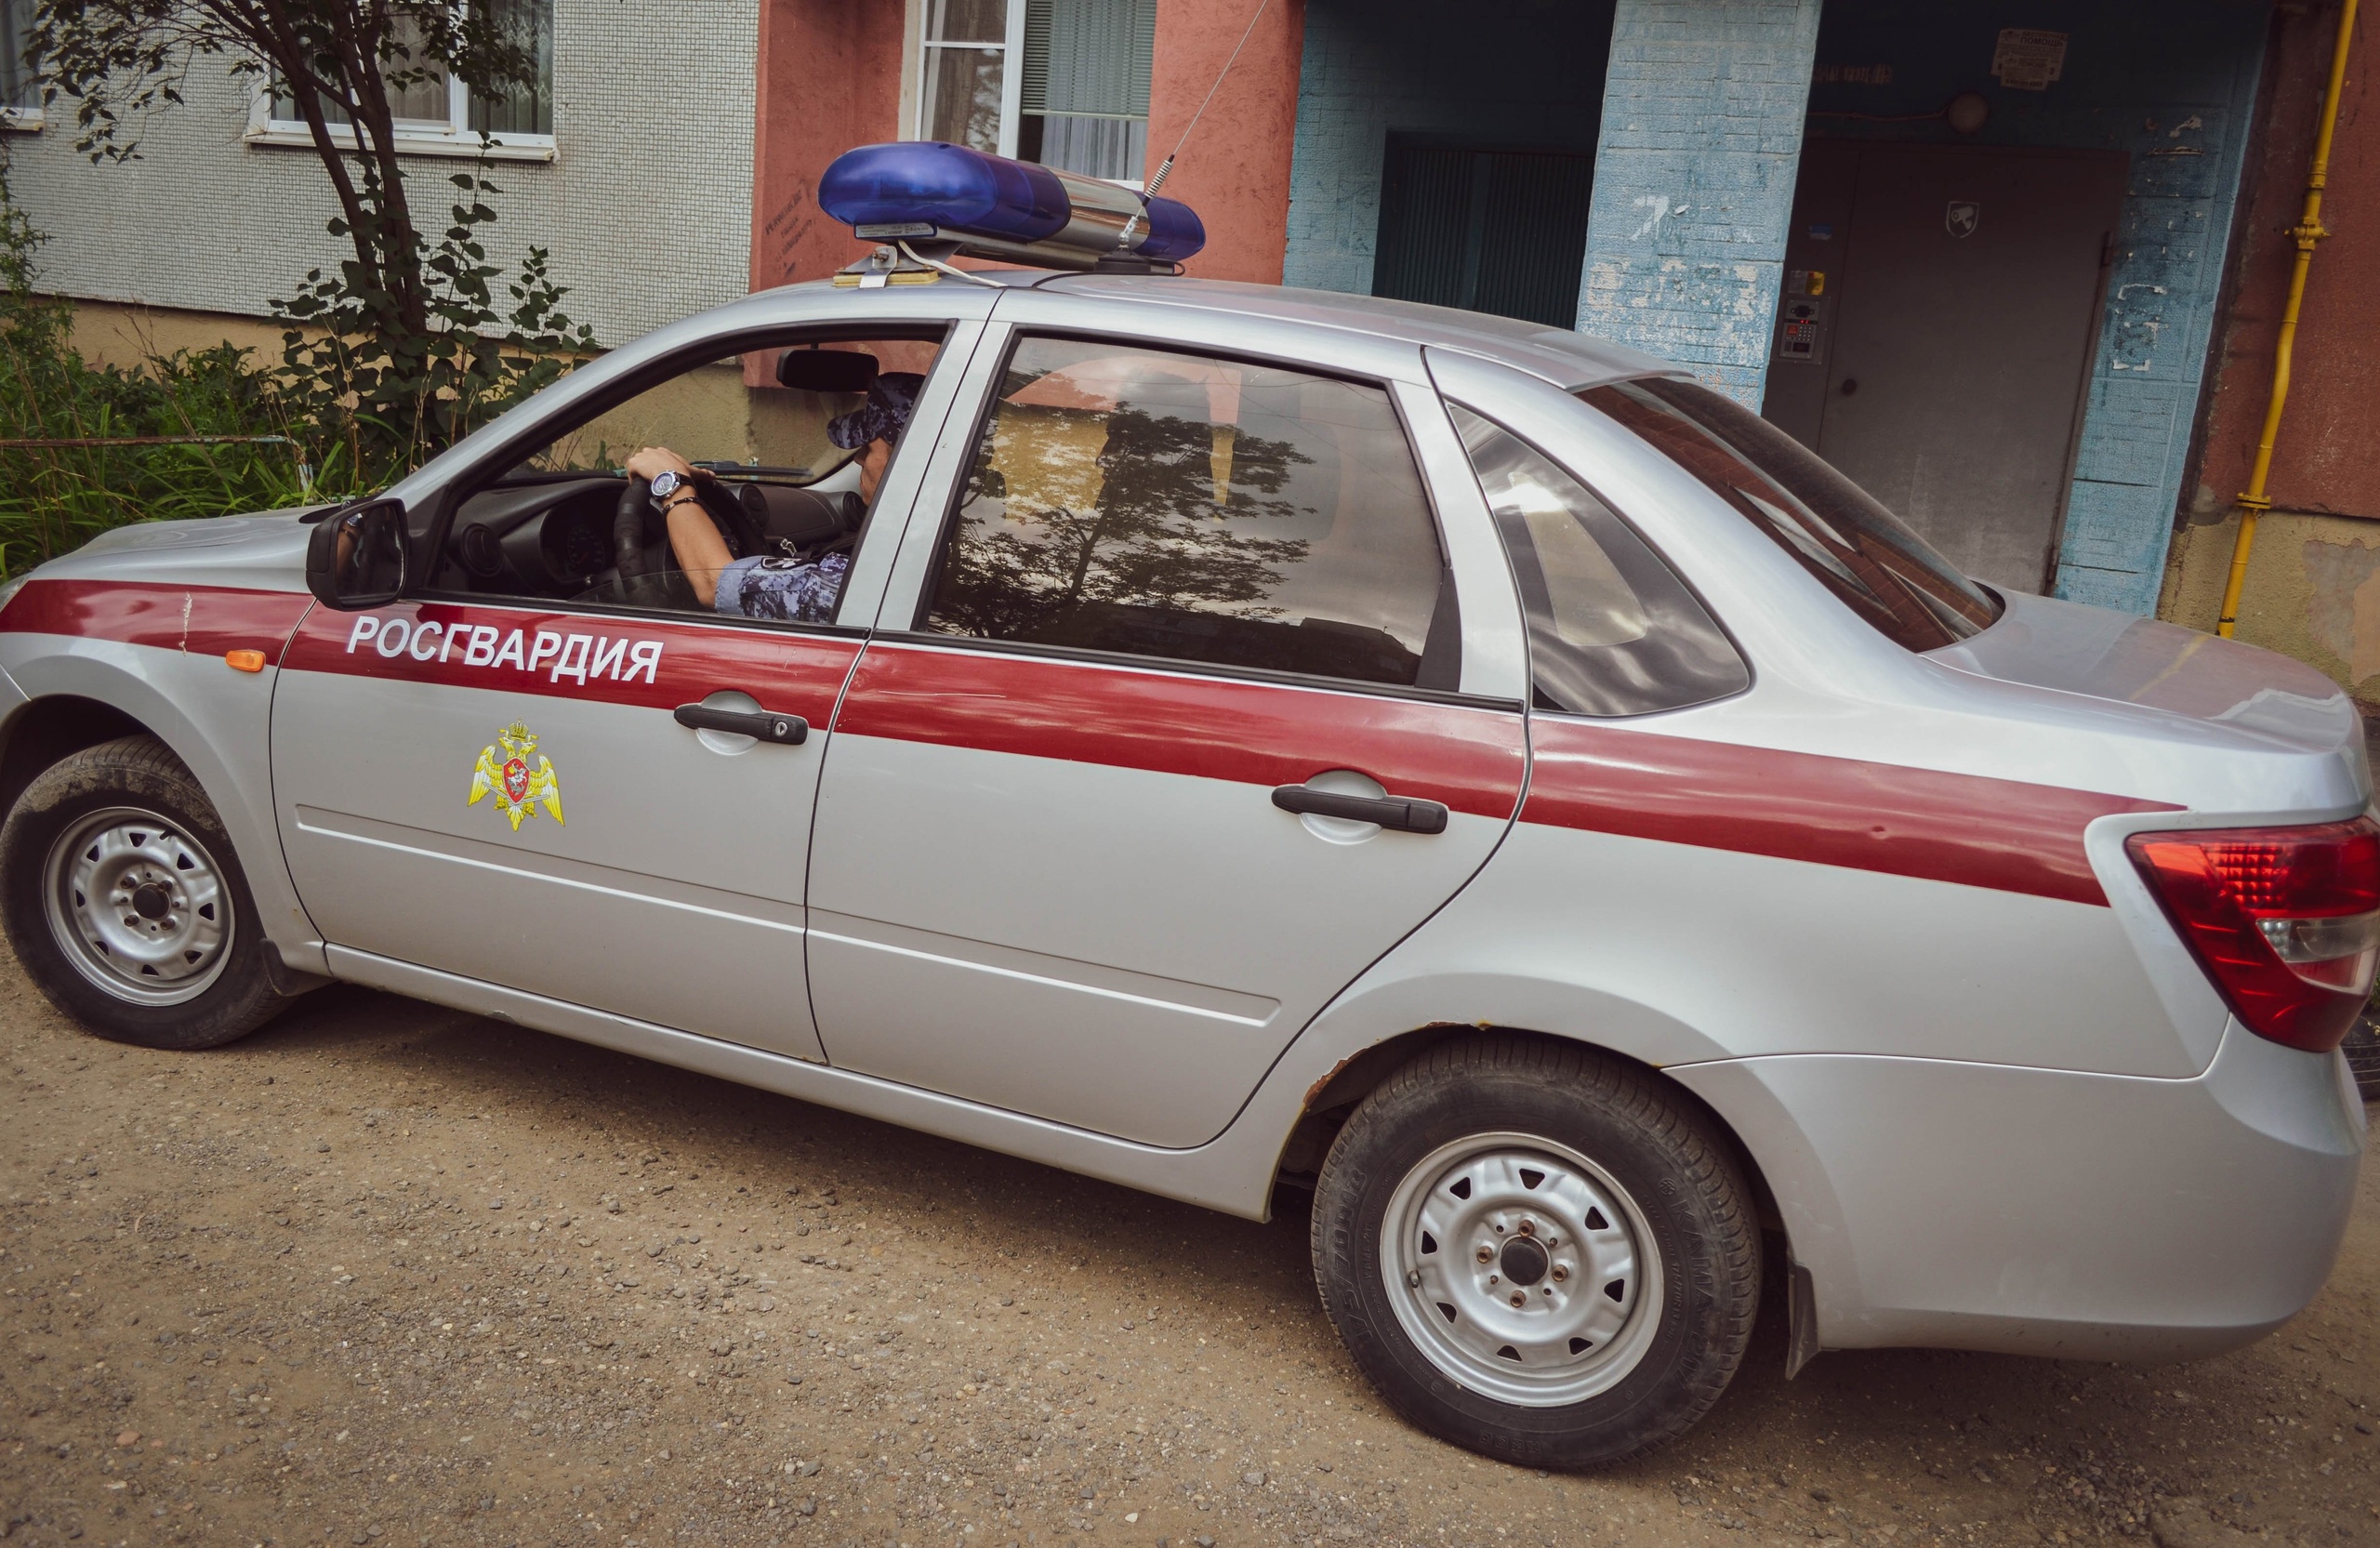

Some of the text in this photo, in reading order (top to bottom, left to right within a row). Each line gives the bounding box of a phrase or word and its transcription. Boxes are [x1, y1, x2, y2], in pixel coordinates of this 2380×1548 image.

[2019, 36, 2064, 47] ПОМОЩЬ
[347, 615, 664, 686] РОСГВАРДИЯ
[1671, 1200, 1714, 1391] KAMA-217
